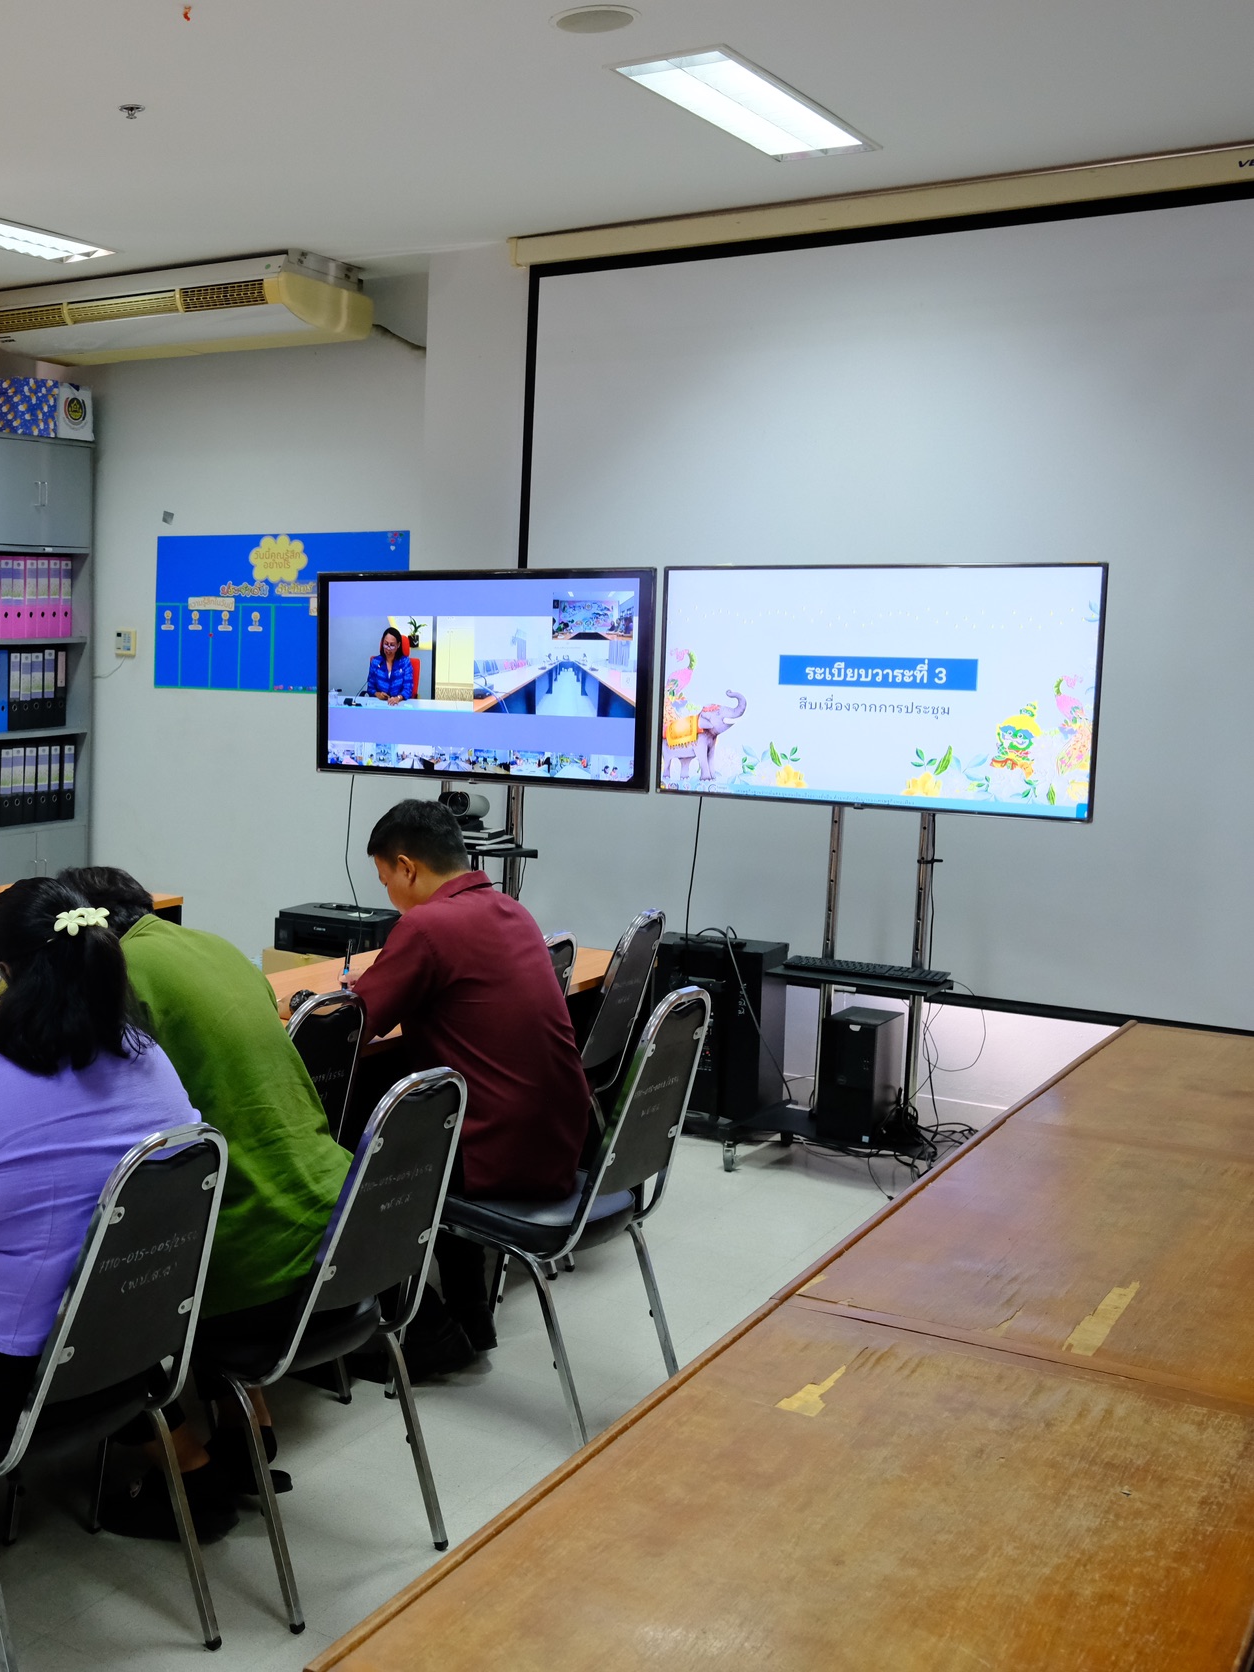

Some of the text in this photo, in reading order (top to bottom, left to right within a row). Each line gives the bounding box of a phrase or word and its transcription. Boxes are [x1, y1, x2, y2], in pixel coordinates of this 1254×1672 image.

[254, 548, 301, 561] วันนี้คุณรู้สึก
[263, 558, 291, 569] อย่างไร
[805, 659, 948, 684] ระเบียบวาระที่ 3
[798, 695, 951, 719] สืบเนื่องจากการประชุม
